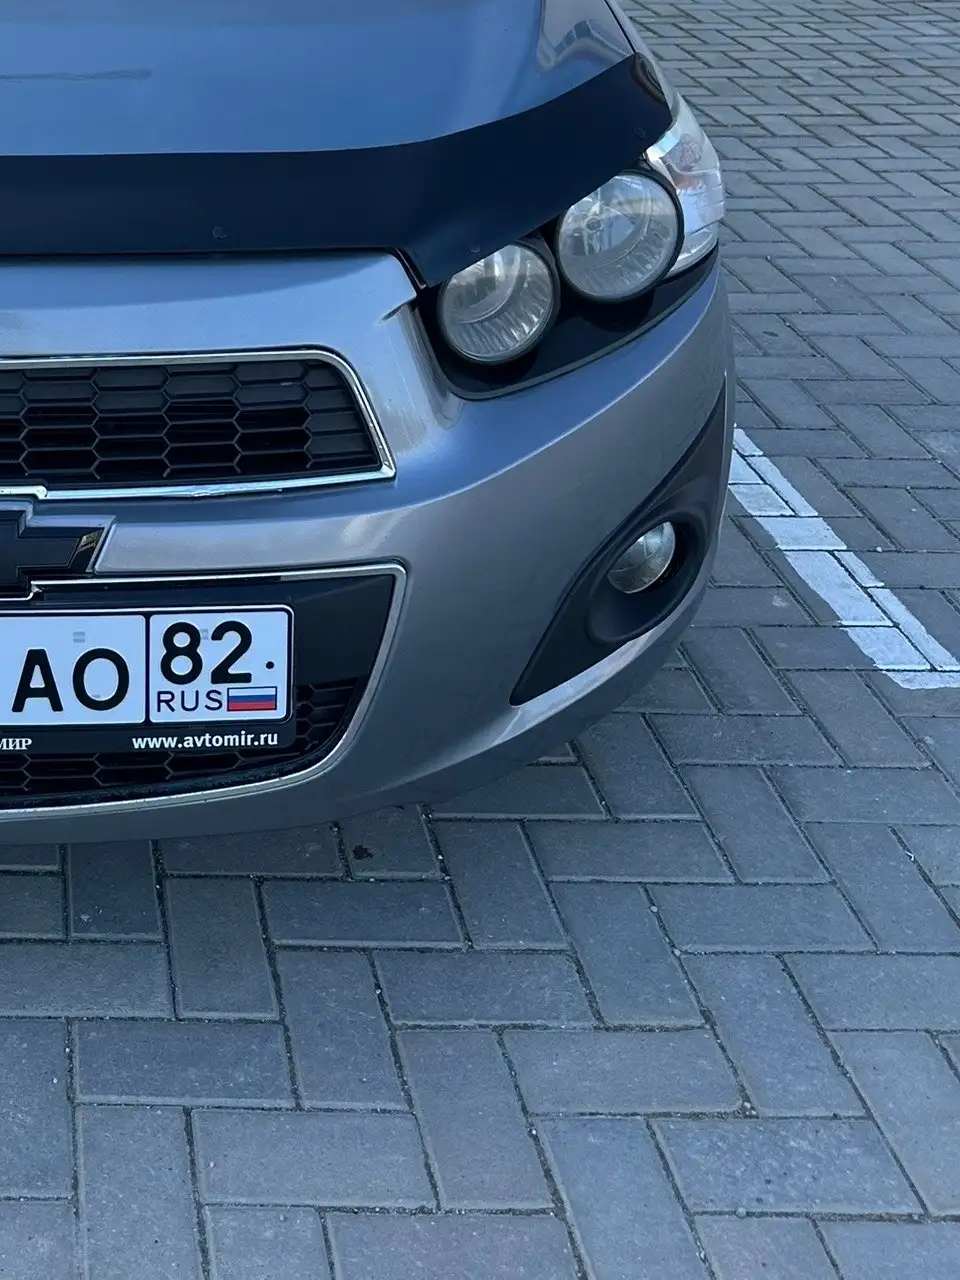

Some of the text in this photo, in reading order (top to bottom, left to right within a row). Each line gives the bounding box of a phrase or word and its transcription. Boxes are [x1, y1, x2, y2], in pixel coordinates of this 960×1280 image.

[160, 620, 252, 685] 82
[156, 690, 223, 713] RUS
[132, 730, 278, 749] www.avtomir.ru
